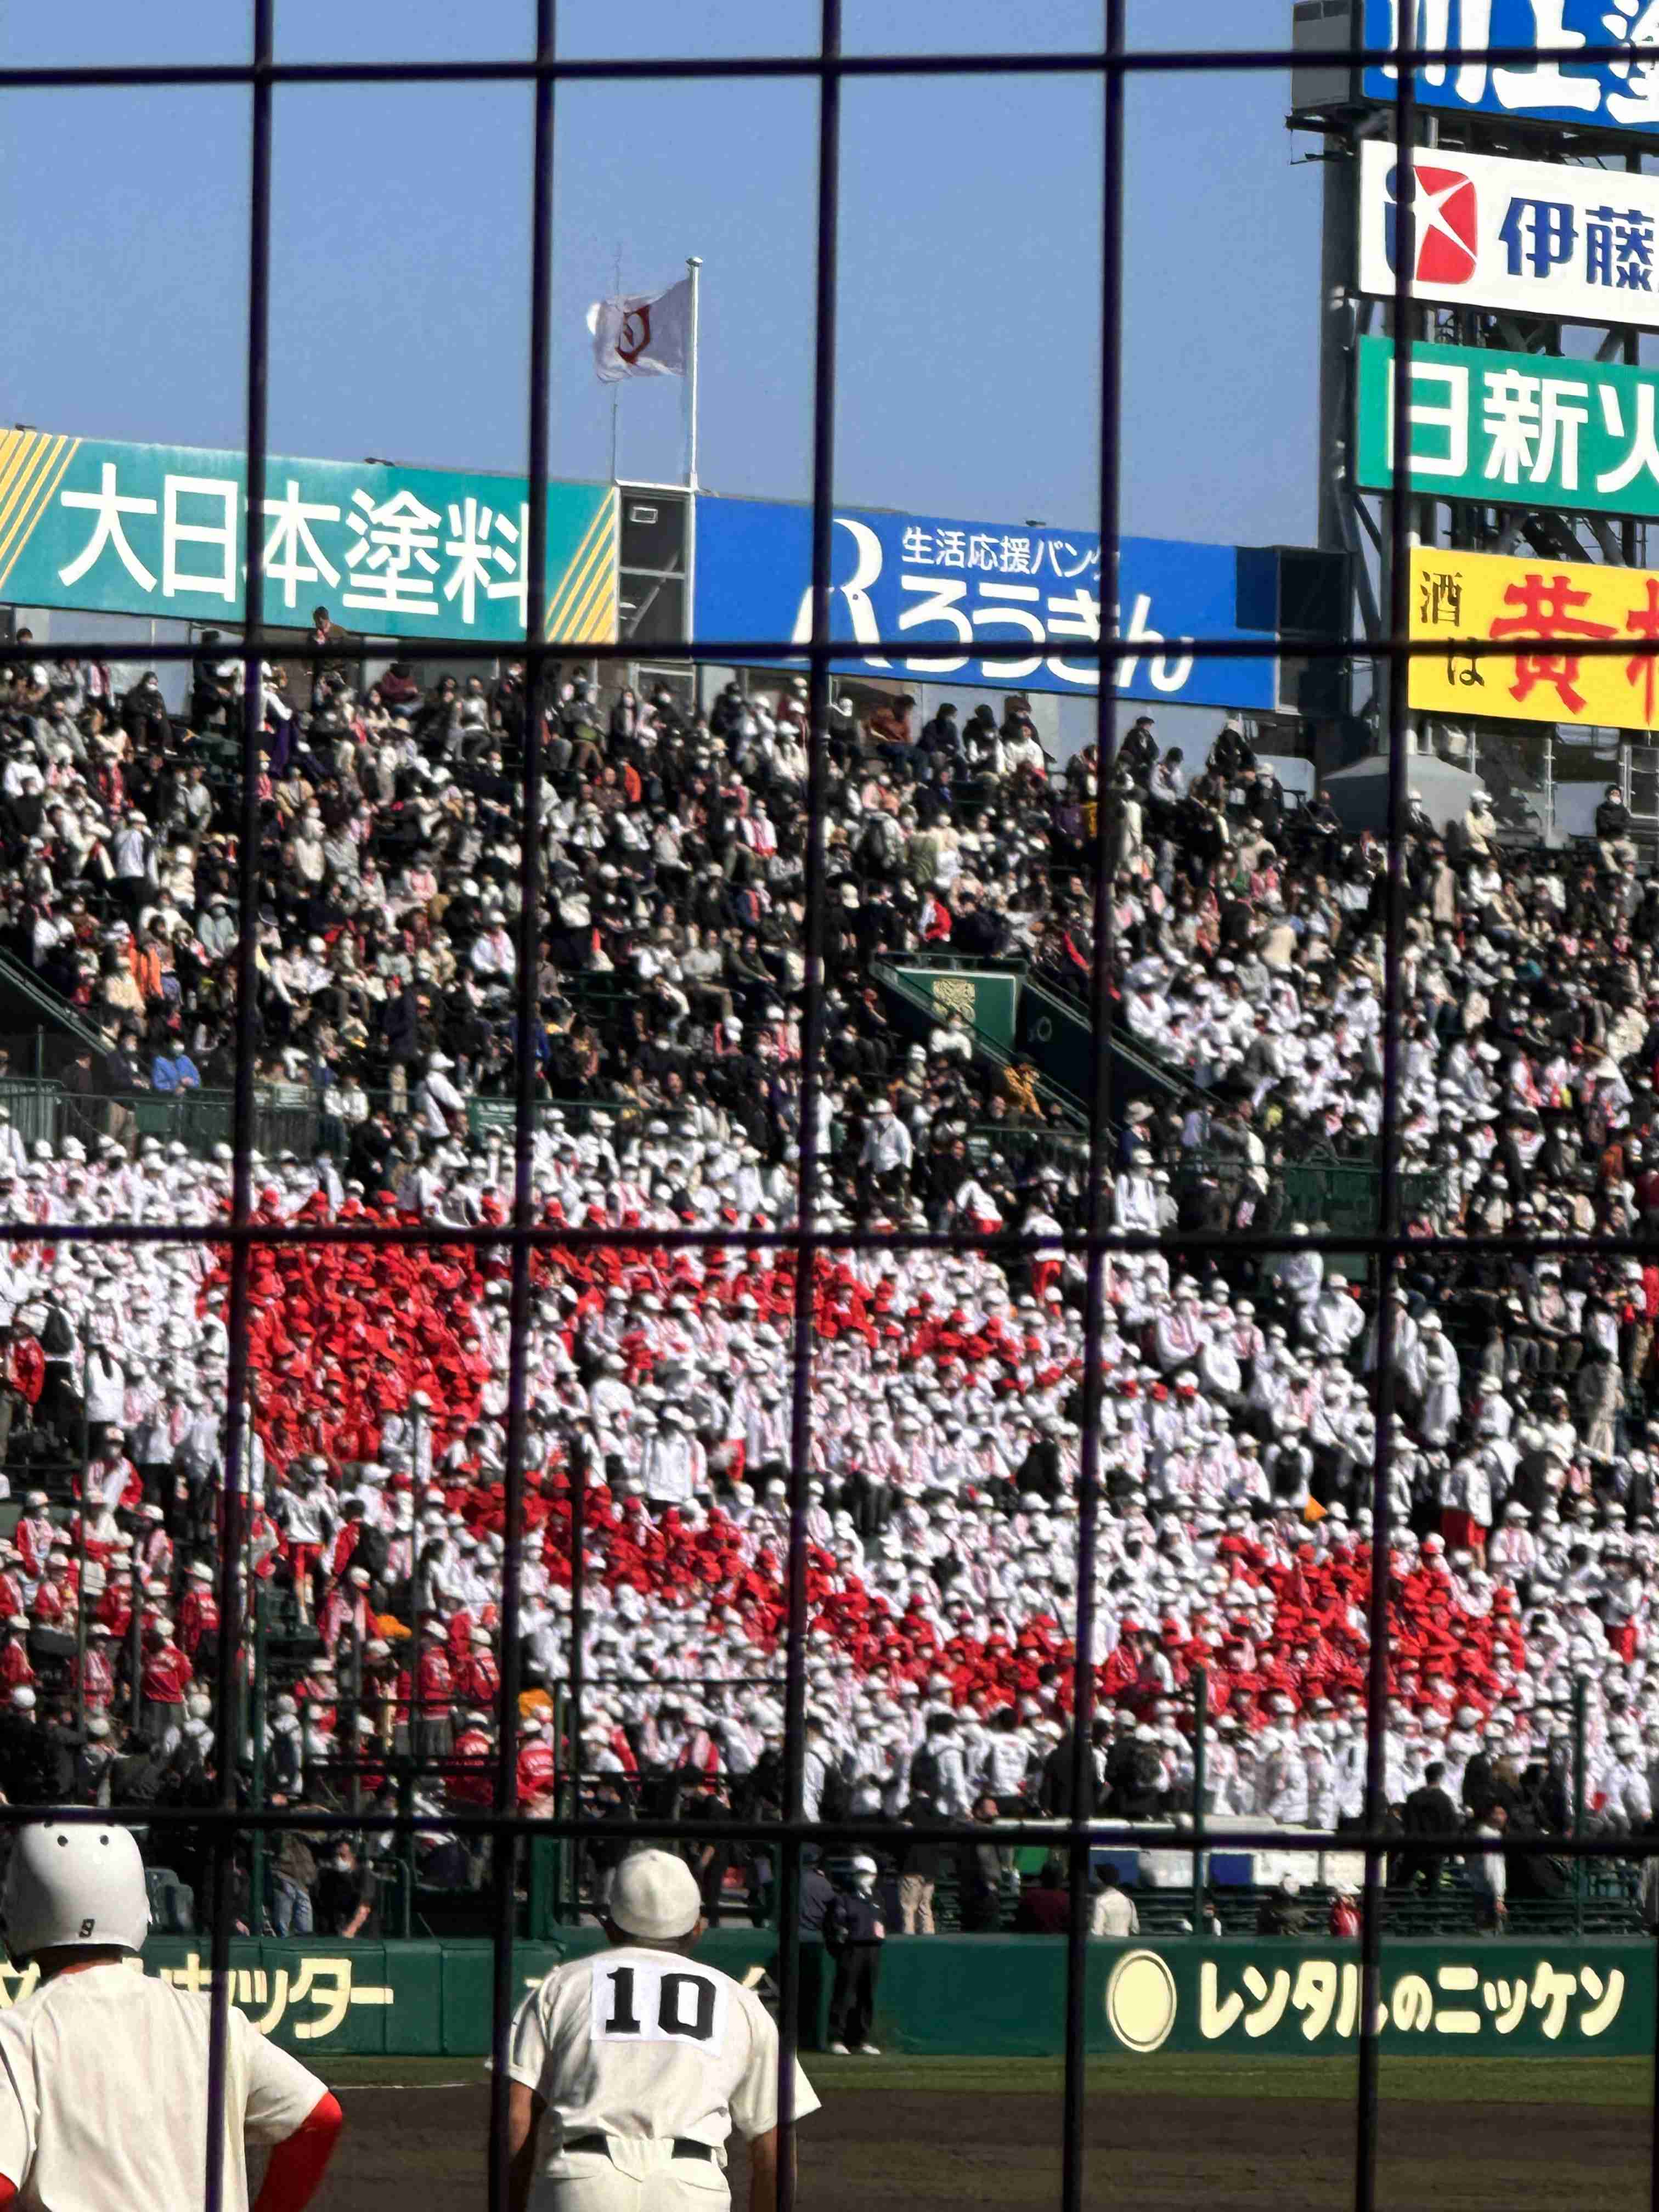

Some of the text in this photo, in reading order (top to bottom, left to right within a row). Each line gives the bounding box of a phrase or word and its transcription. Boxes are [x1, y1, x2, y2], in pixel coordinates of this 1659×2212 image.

[1498, 196, 1654, 292] 伊藤
[59, 462, 530, 627] 大日本塗料
[605, 1967, 716, 2041] 10
[1200, 1960, 1624, 2041] レンタルのニッケン
